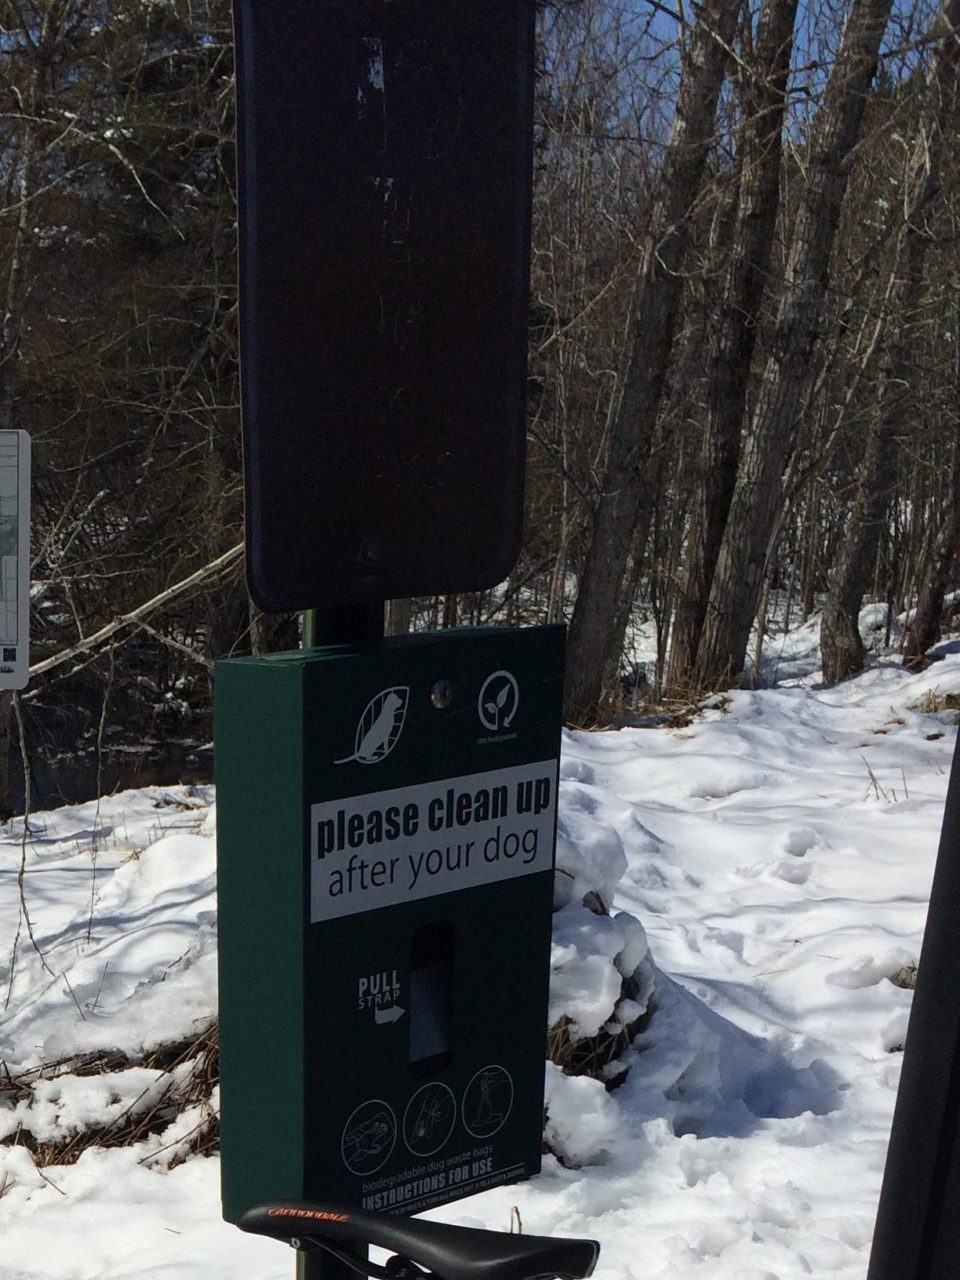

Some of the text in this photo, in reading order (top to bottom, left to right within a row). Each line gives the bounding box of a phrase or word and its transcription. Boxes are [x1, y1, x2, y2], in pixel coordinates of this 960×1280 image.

[317, 776, 551, 859] please clean up
[328, 825, 539, 897] after your dog
[358, 969, 401, 998] PULL
[358, 989, 400, 1010] STRAP
[362, 1144, 494, 1194] biodegradable dog waste bags
[362, 1175, 446, 1211] INSTRUCTIONS
[448, 1165, 469, 1185] FOR
[472, 1157, 493, 1177] USE
